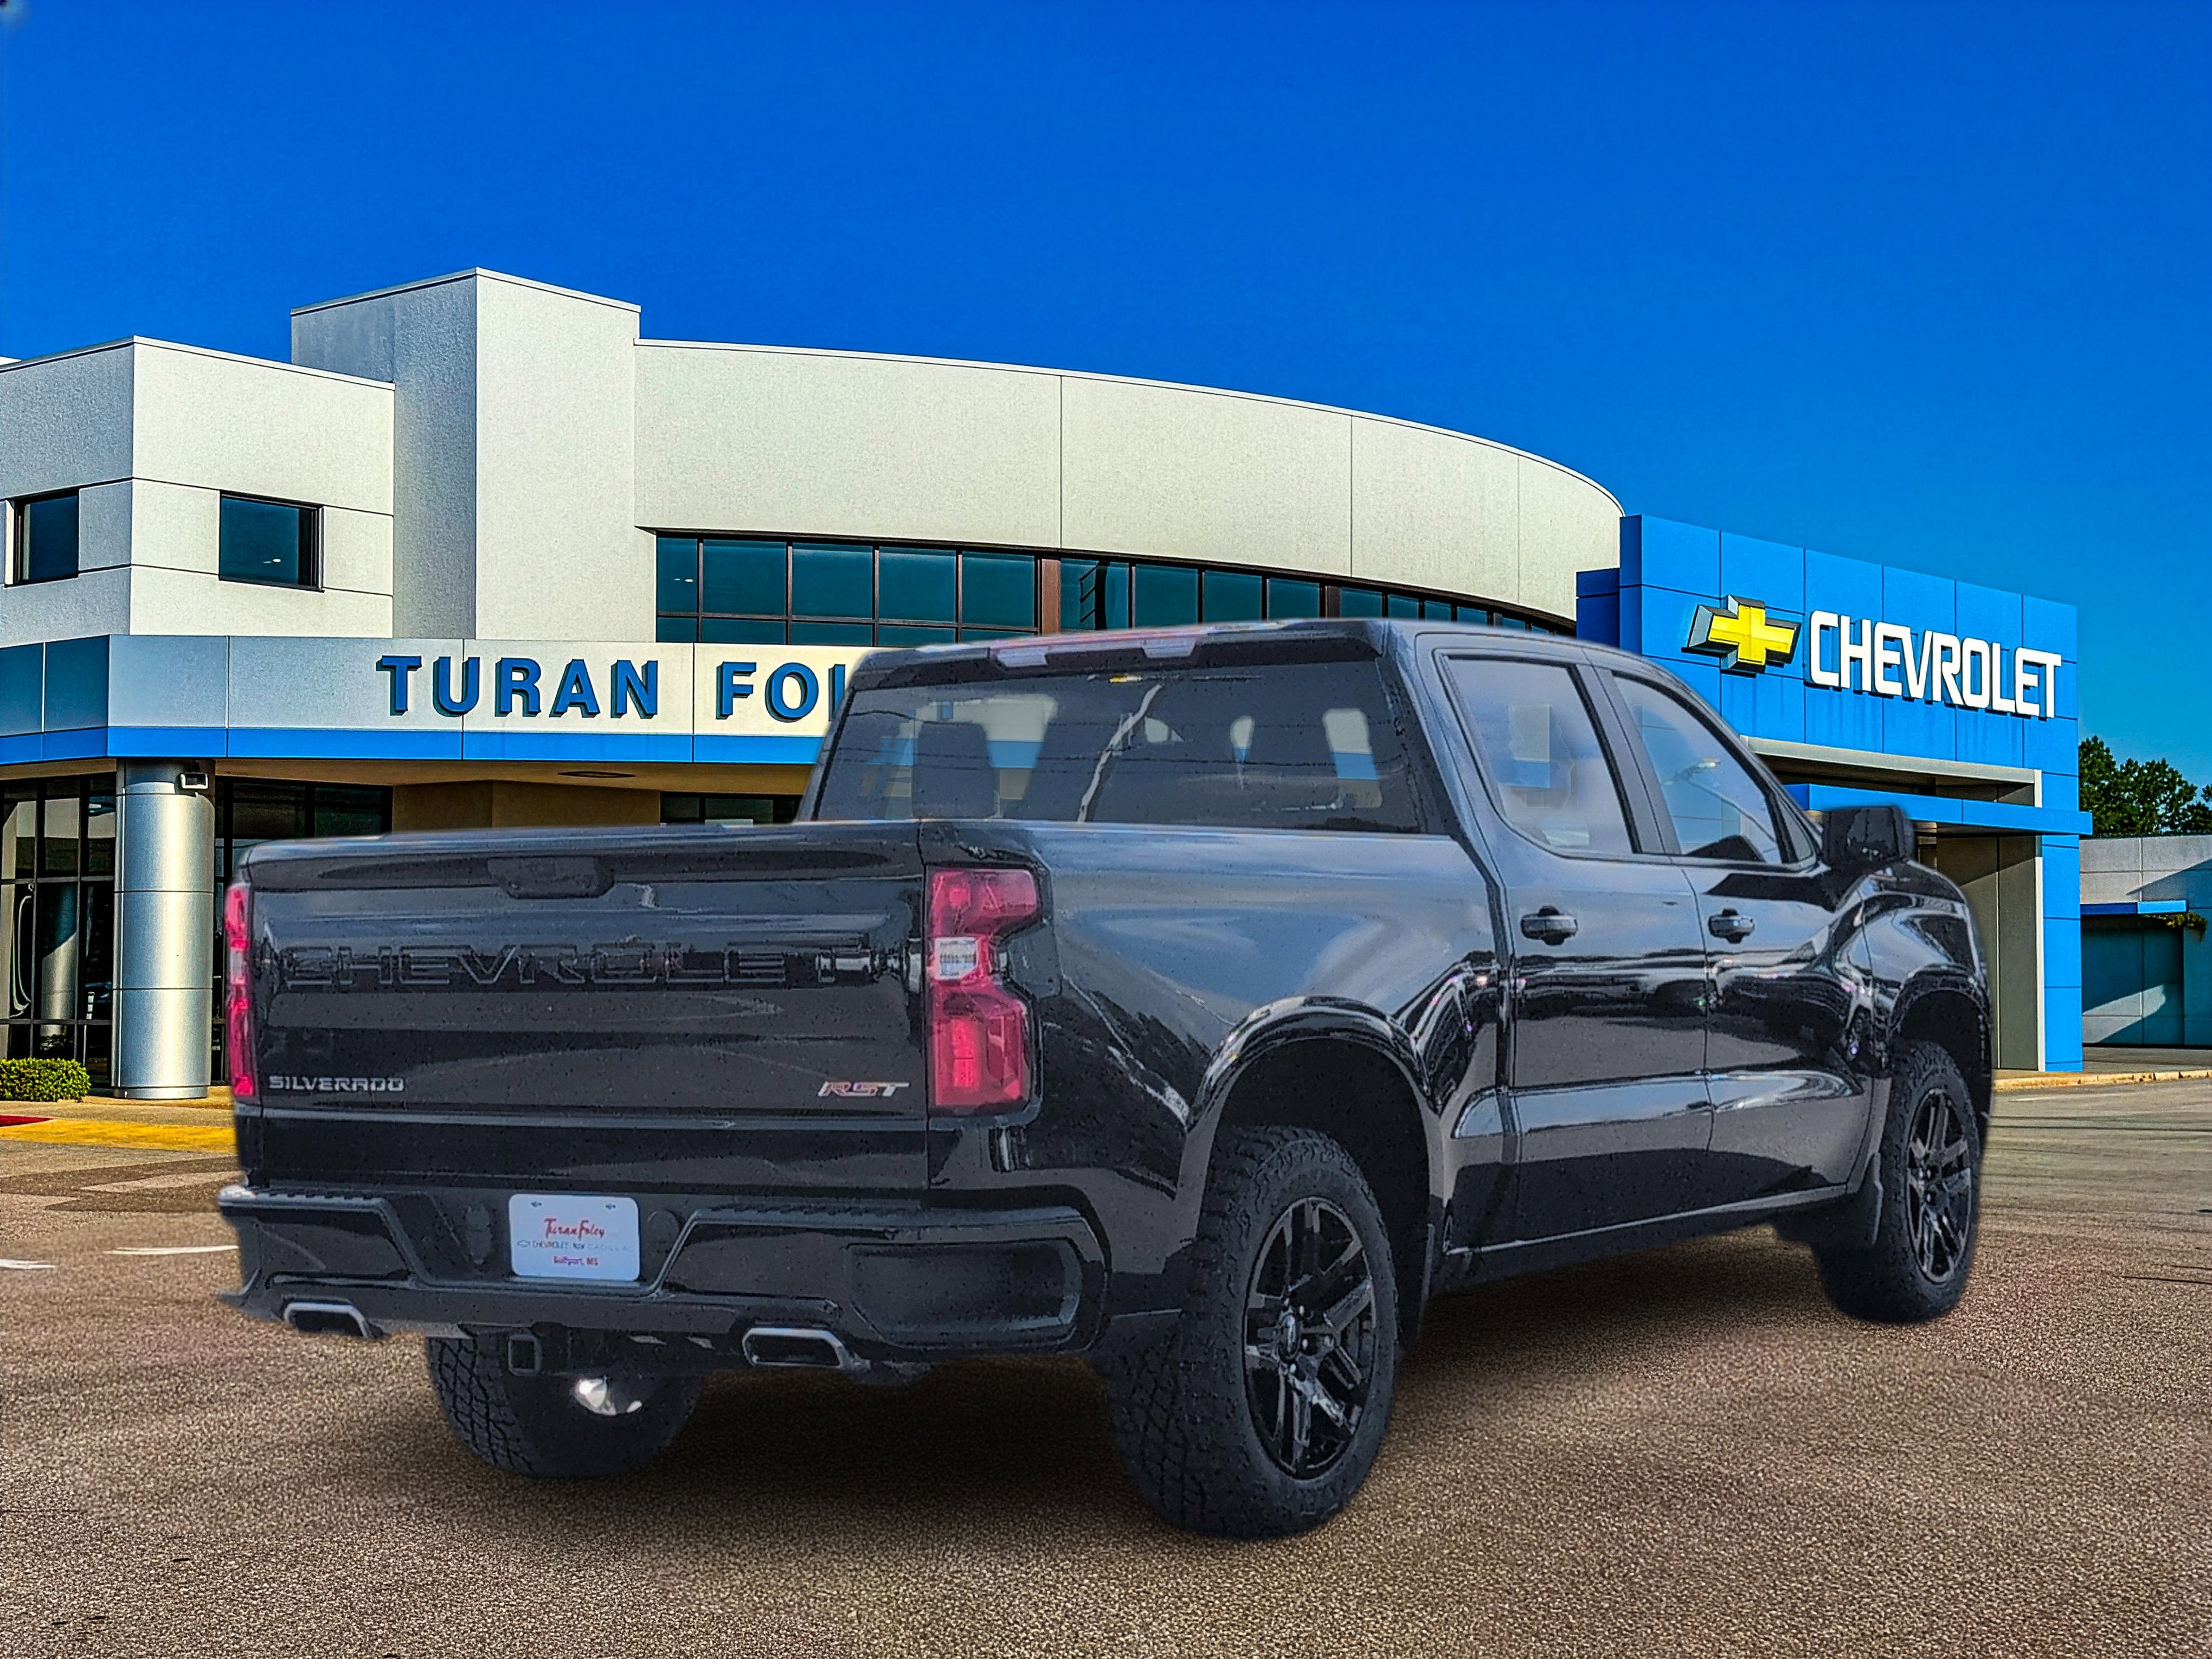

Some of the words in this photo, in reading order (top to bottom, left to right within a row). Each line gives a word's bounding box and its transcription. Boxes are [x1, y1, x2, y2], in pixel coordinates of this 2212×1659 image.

[1810, 610, 2062, 718] CHEVROLET
[376, 655, 658, 719] TURAN
[279, 940, 863, 985] CHEVROLET
[269, 1075, 404, 1091] SILVERADO
[818, 1081, 909, 1097] RST
